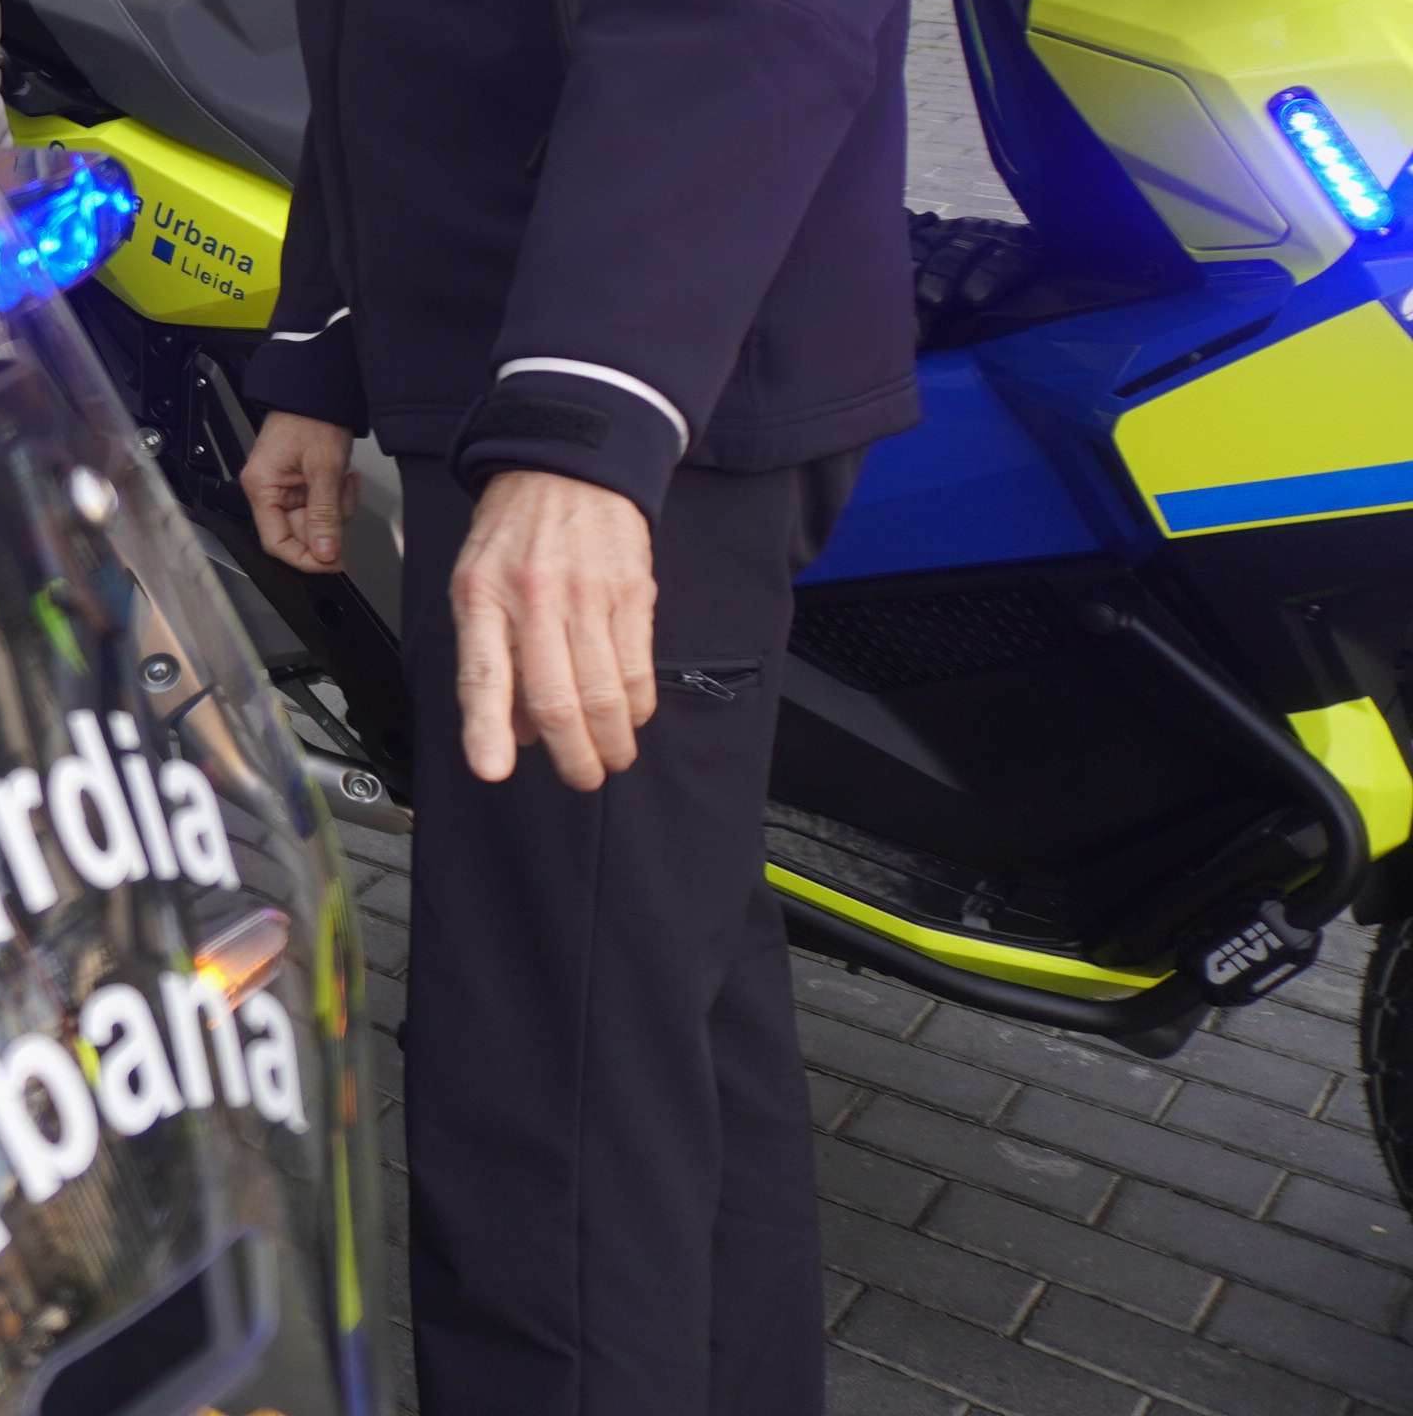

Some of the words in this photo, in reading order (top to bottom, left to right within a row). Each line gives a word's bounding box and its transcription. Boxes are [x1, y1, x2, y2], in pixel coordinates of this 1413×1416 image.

[154, 201, 254, 275] Urbana
[180, 256, 245, 301] Lleida
[1206, 921, 1285, 985] GIVI
